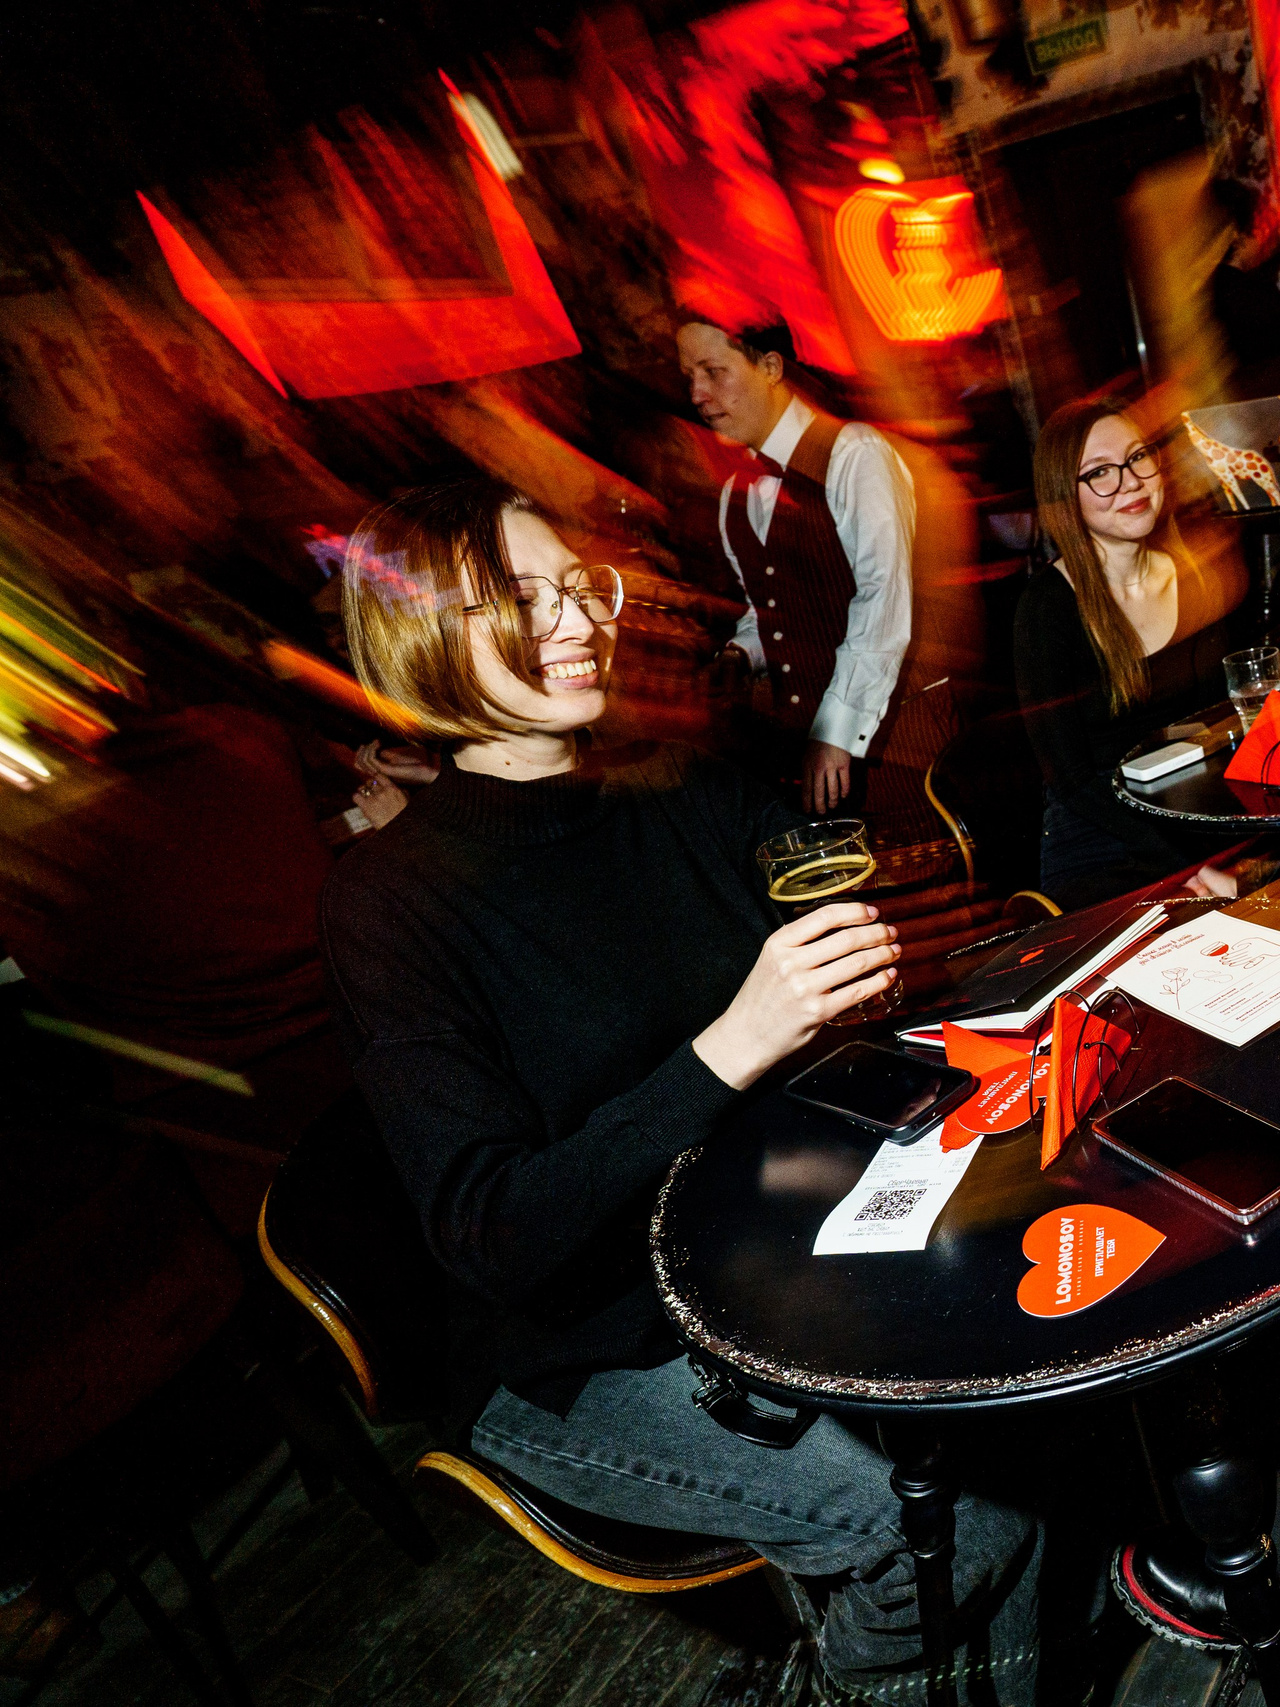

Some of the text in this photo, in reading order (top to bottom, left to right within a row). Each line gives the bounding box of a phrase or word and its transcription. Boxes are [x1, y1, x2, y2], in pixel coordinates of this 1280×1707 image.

[978, 1071, 1018, 1108] ПРИГЛАШАЕТ
[982, 1082, 1000, 1096] ТЕБЯ
[1055, 1217, 1075, 1305] LOMONOSOV
[1094, 1226, 1105, 1277] ПРИГЛАШАЕТ
[1106, 1238, 1116, 1259] ТЕБЯ
